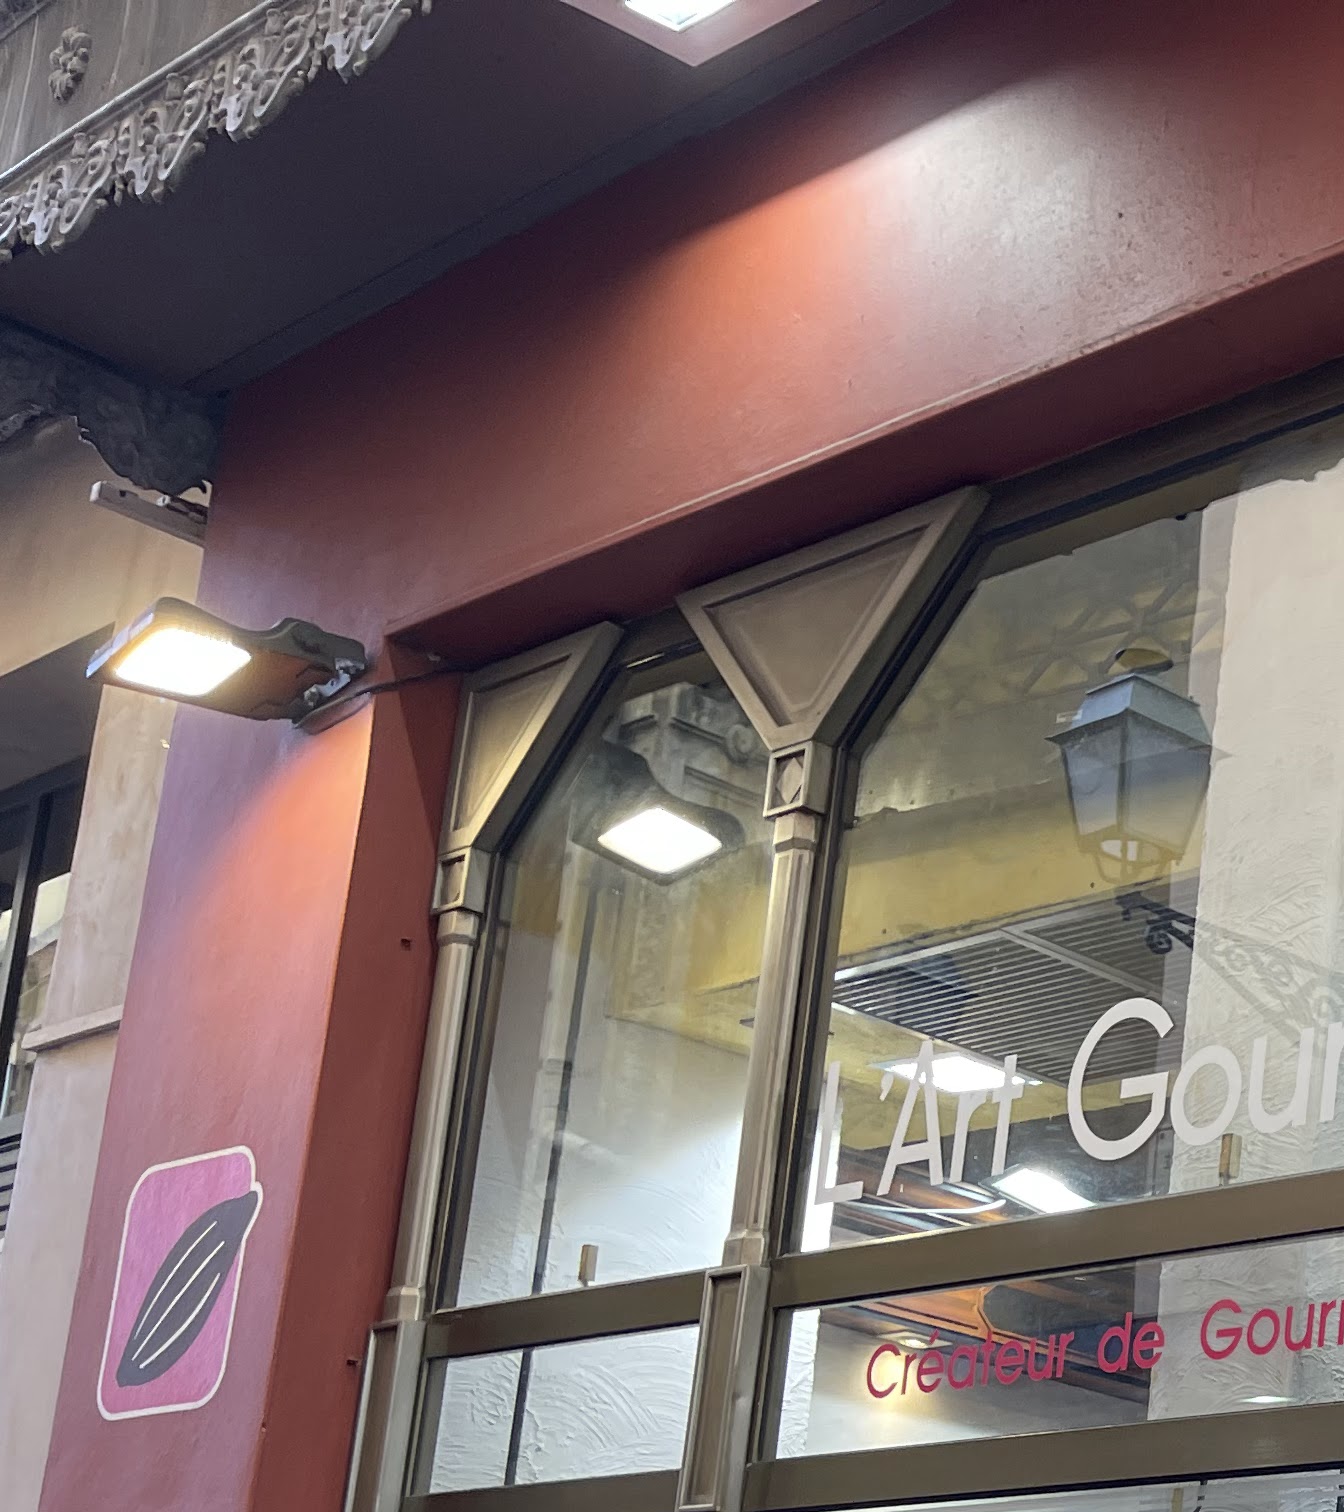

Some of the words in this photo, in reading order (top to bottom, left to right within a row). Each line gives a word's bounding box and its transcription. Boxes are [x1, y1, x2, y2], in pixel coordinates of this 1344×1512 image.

[813, 1040, 1024, 1205] L'Art
[865, 1328, 1076, 1399] Créateur
[1097, 1310, 1165, 1374] de
